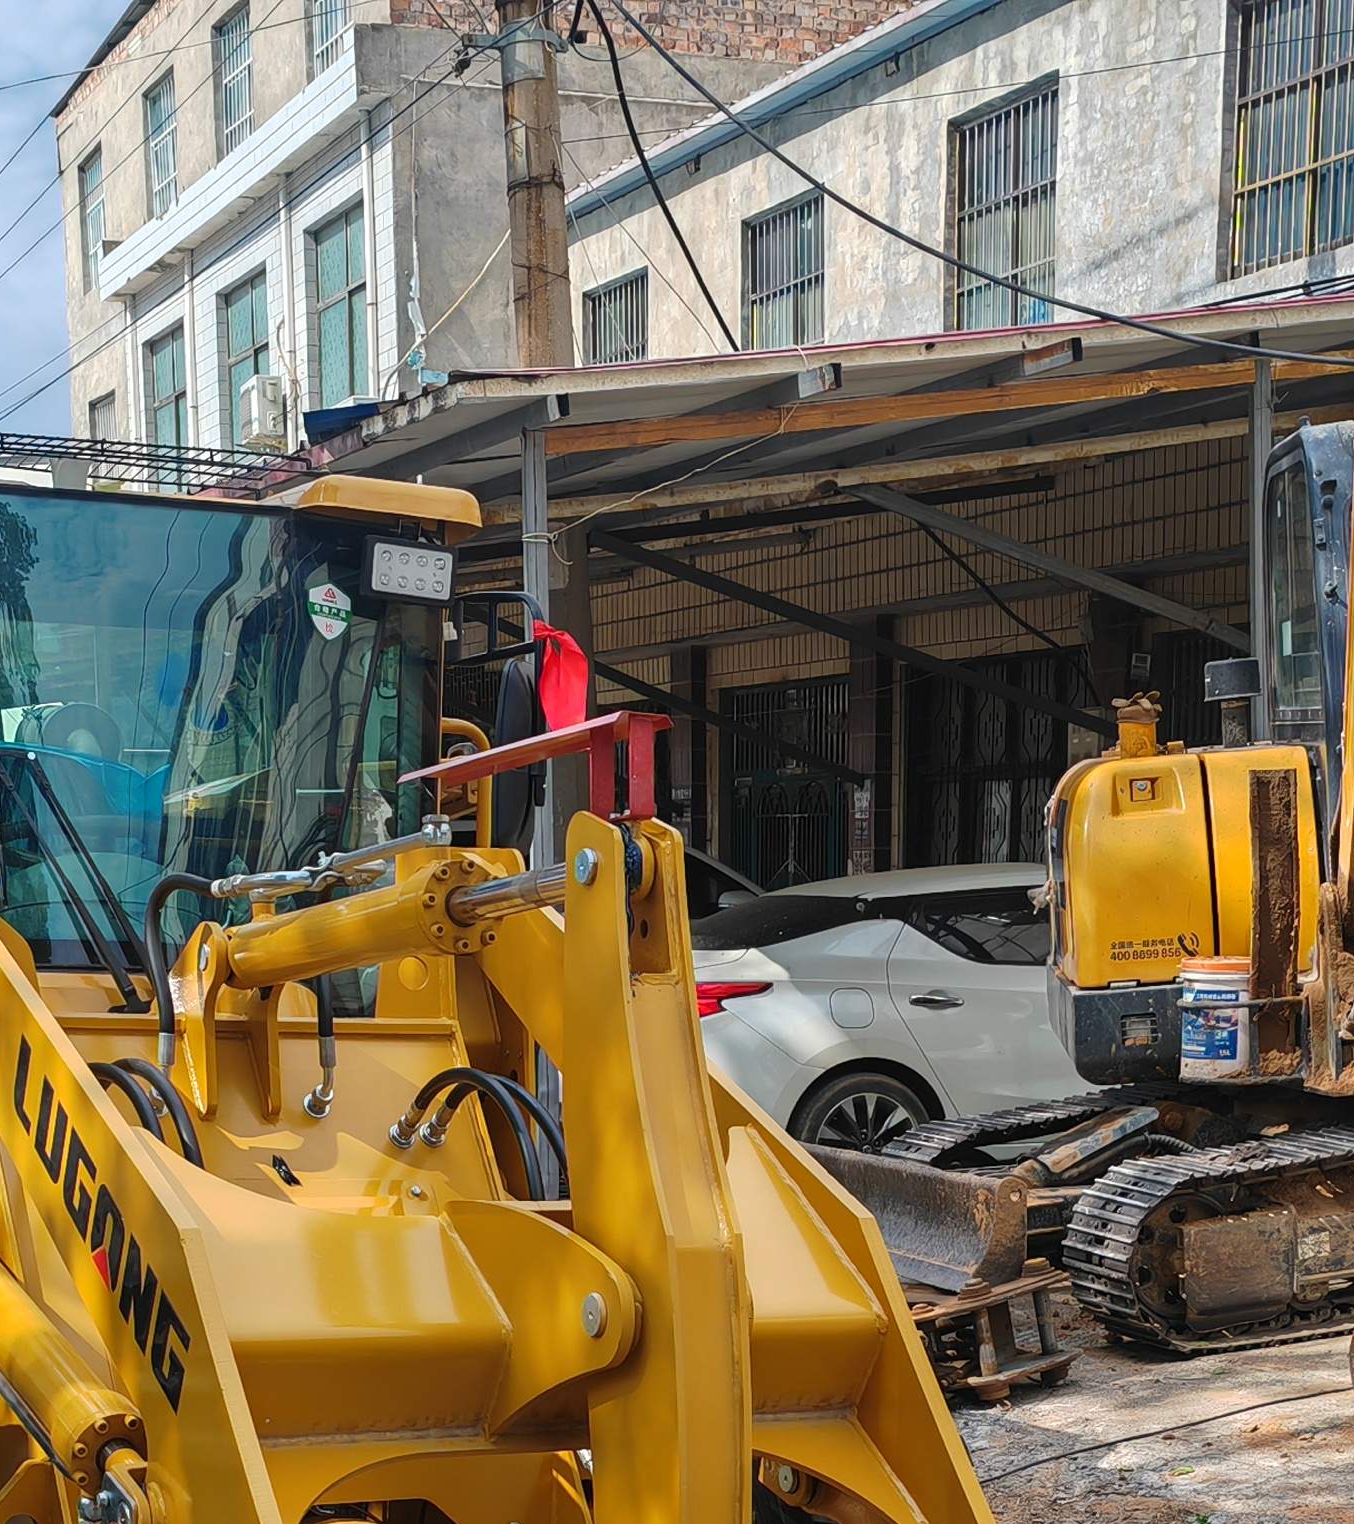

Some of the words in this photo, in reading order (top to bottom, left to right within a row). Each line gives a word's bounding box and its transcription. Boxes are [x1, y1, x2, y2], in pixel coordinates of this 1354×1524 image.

[1110, 950, 1131, 961] 400
[1161, 947, 1182, 958] 856
[14, 1033, 191, 1414] LUGONG
